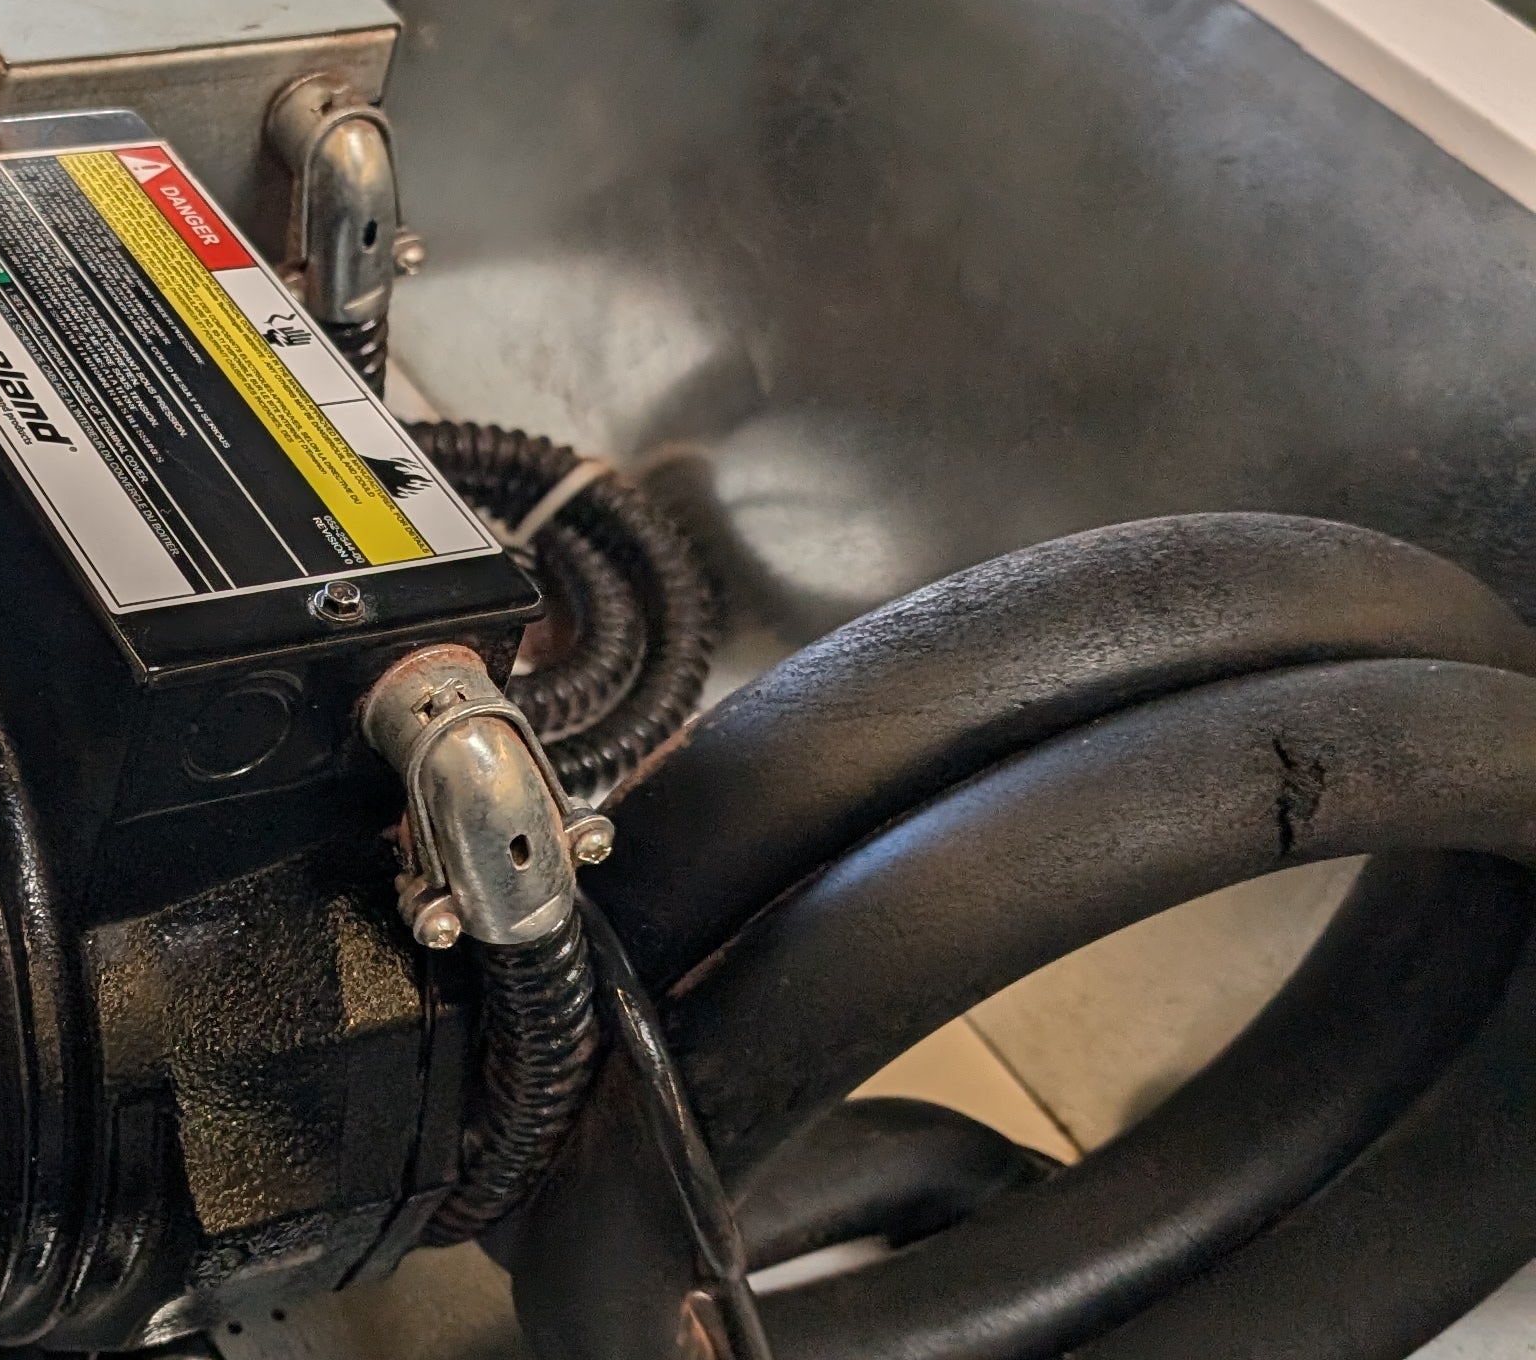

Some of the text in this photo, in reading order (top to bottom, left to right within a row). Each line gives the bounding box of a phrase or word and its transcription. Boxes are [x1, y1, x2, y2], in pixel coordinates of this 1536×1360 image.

[158, 186, 221, 245] DANGER
[8, 294, 25, 308] SEE
[19, 309, 44, 334] WIRING
[38, 335, 68, 367] DIAGRAM
[61, 367, 76, 379] ON
[69, 380, 94, 403] INSIDE
[87, 405, 102, 415] OF
[96, 416, 129, 453] TERMINAL
[123, 454, 151, 483] COVER.
[2, 412, 35, 445] products
[3, 314, 17, 322] LE
[10, 323, 38, 352] SCHEMA
[31, 353, 46, 363] DE
[39, 364, 70, 397] CABLAGE
[99, 449, 115, 461] DU
[108, 462, 148, 509] COUVERCLE
[141, 509, 157, 521] DU
[311, 516, 348, 557] REVISION
[322, 514, 366, 563] 052-2544-00
